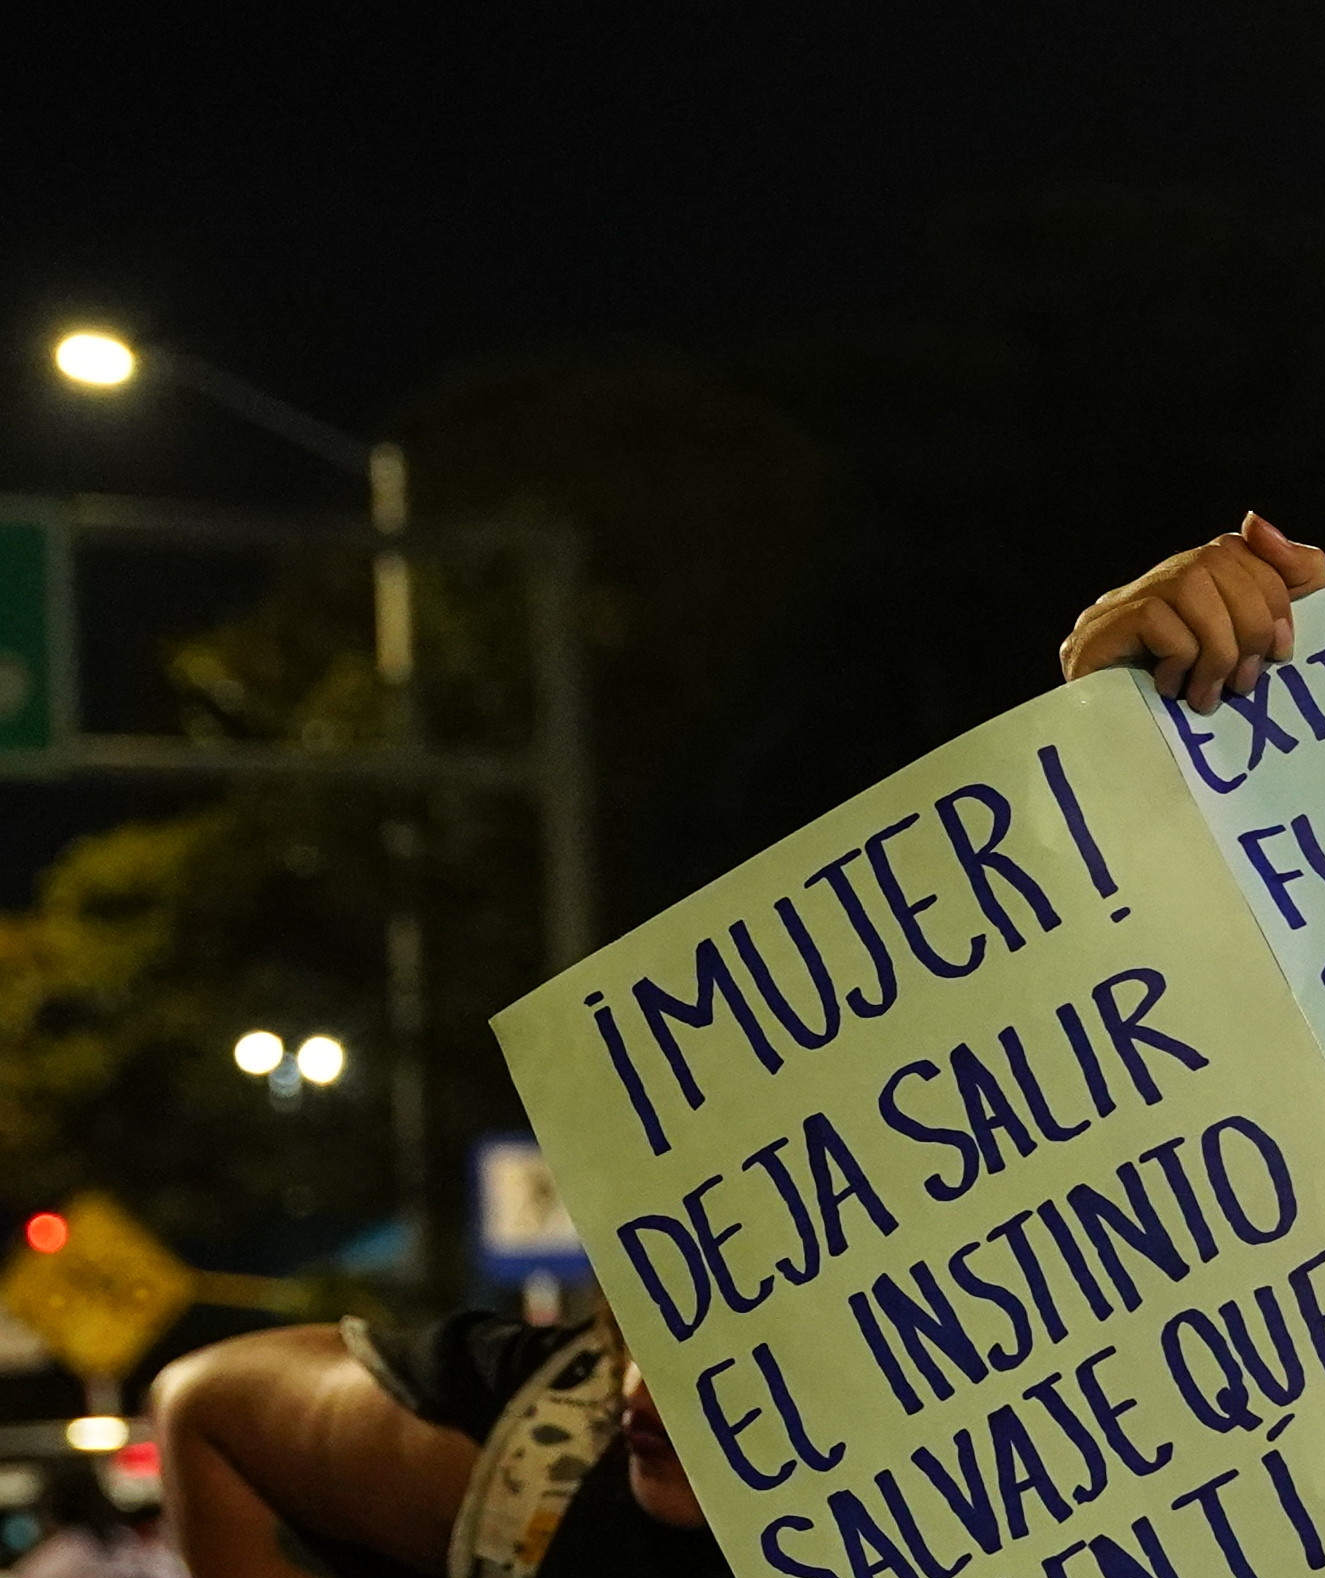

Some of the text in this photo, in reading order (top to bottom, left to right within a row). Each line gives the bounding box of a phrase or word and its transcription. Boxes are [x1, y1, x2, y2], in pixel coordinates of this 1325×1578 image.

[582, 744, 1131, 1157] ¡MUJER!
[614, 966, 1211, 1343] DEJA SALIR
[694, 1114, 1299, 1492] EL INSTINTO
